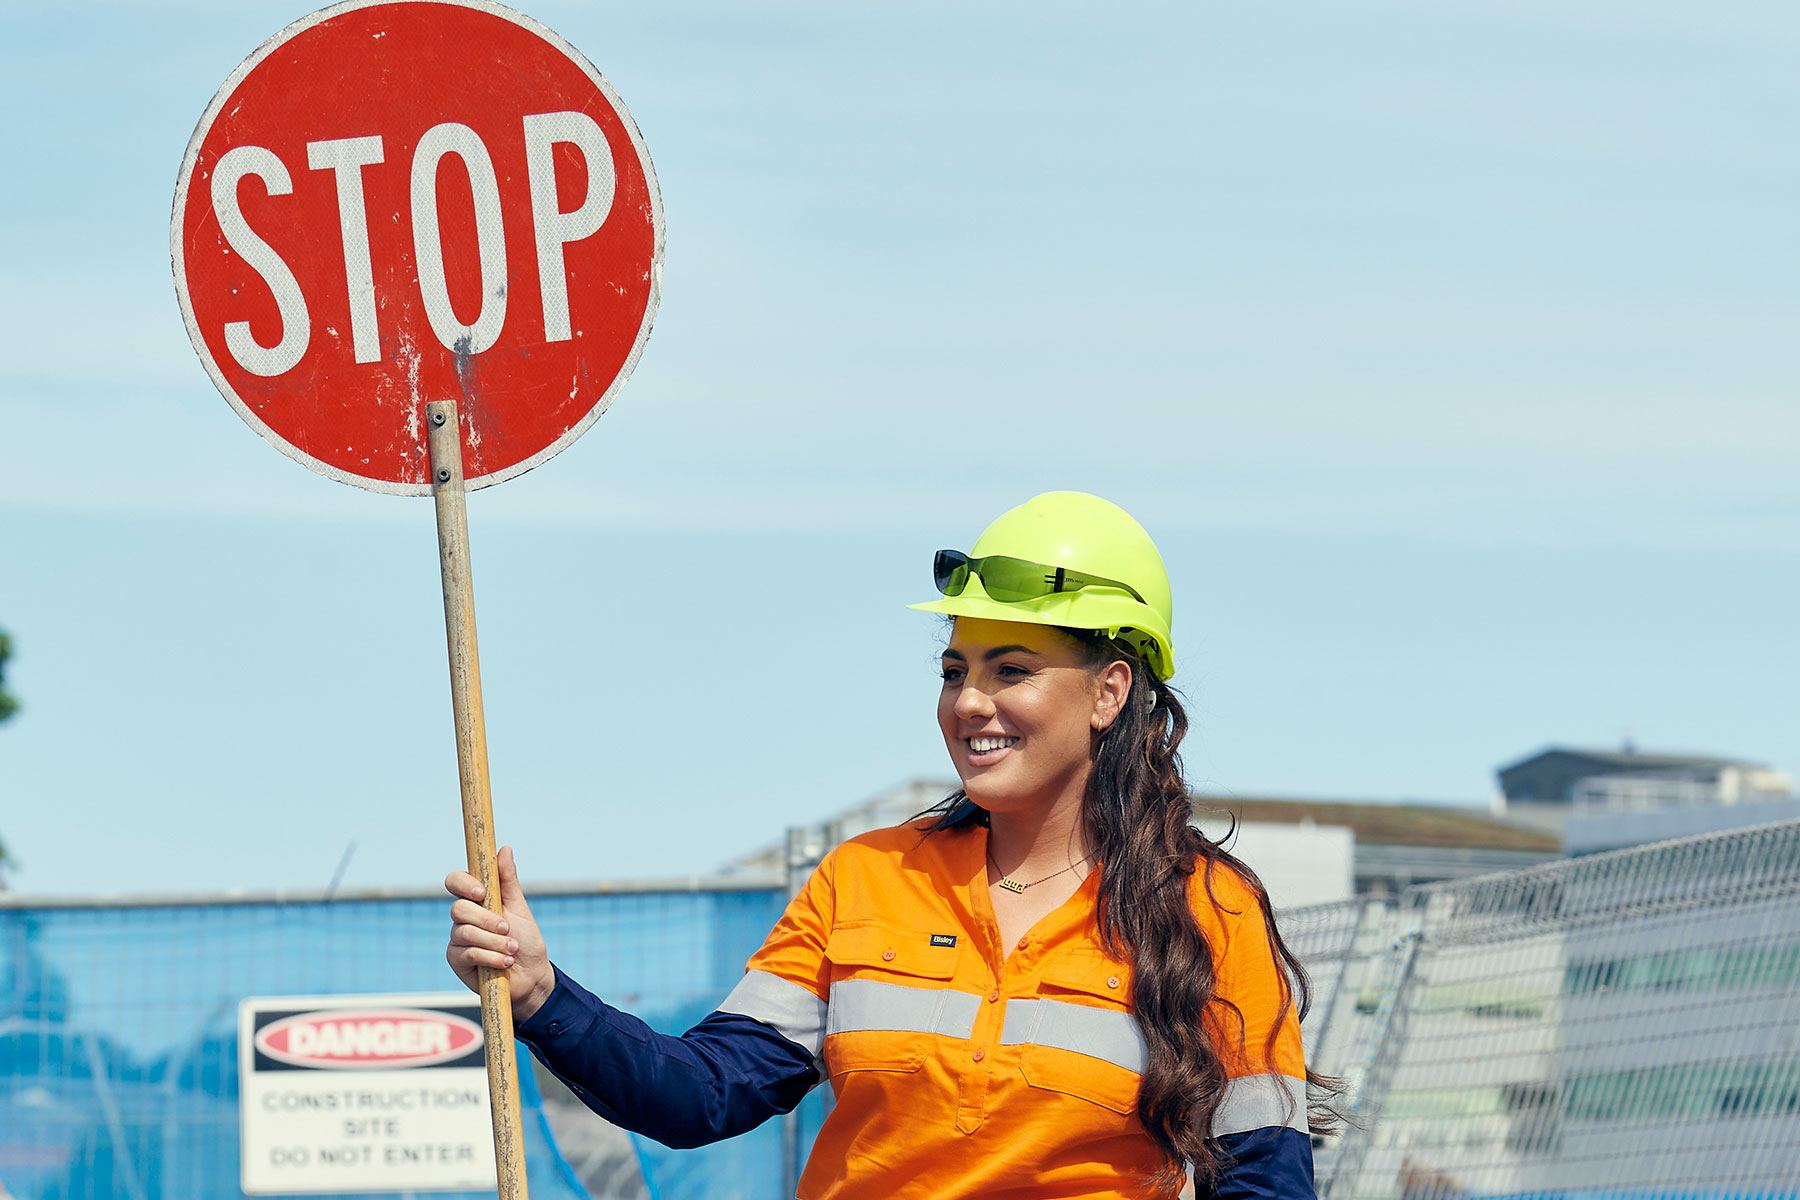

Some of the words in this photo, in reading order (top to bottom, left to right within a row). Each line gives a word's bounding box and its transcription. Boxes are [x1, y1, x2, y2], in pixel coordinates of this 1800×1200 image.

[210, 110, 616, 377] STOP
[287, 1021, 452, 1057] DANGER
[262, 1087, 481, 1112] CONSTRUCTION
[343, 1117, 400, 1138] SITE
[270, 1147, 310, 1168] DO
[319, 1146, 373, 1166] NOT
[383, 1144, 474, 1165] ENTER
